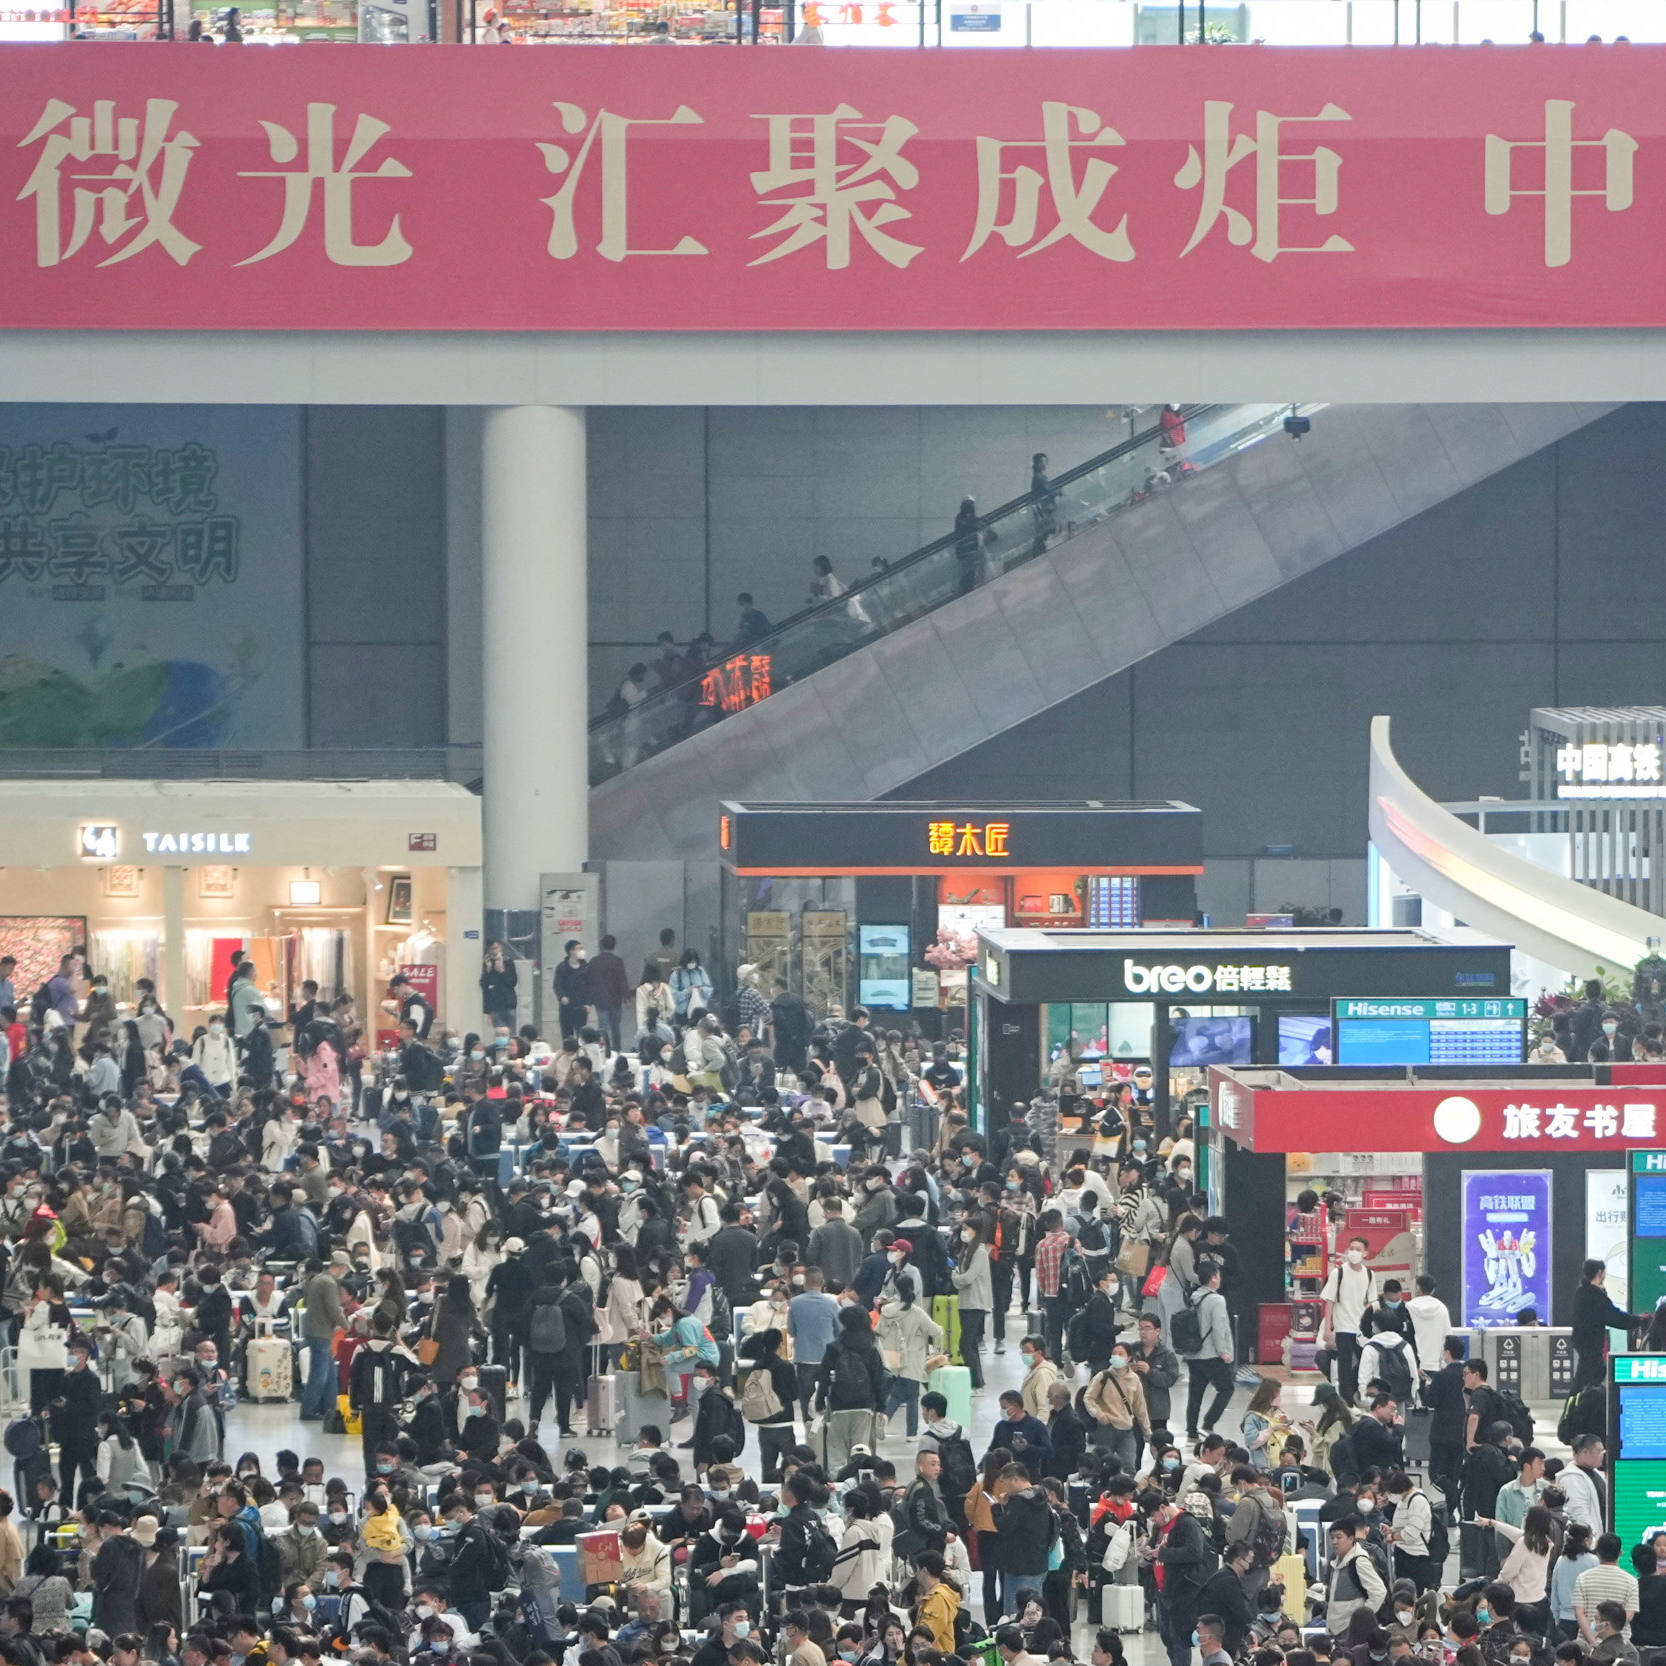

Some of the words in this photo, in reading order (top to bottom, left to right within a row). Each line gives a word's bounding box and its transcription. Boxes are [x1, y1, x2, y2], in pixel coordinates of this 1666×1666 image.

[536, 100, 1355, 270] 汇聚成炬
[143, 833, 250, 852] TAISILK
[929, 822, 1010, 856] 譚木匠
[403, 967, 435, 977] SALE
[1124, 959, 1212, 992] breo
[1348, 1003, 1424, 1015] Hisense
[1462, 1003, 1477, 1014] 1-3
[1503, 1104, 1656, 1139] 旅友书屋
[1480, 1195, 1535, 1210] 高铁联盟
